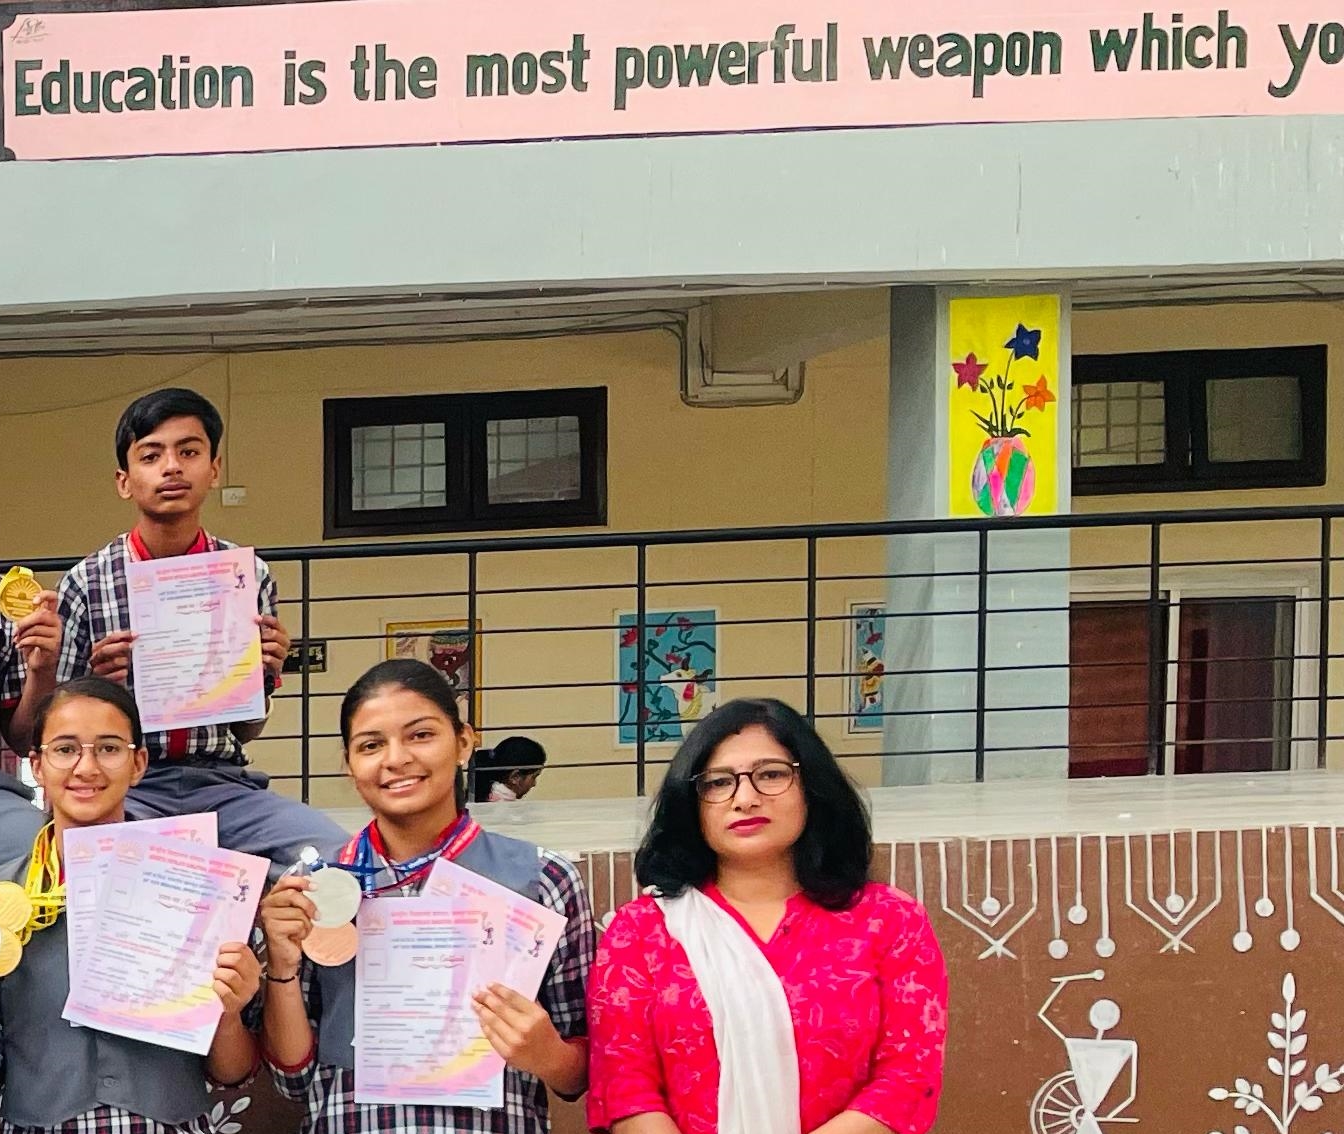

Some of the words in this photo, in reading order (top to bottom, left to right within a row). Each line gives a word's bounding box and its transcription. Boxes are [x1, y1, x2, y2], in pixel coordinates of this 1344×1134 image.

[14, 54, 254, 117] Education
[283, 50, 327, 106] is
[350, 43, 438, 102] the
[466, 33, 591, 98] most
[613, 22, 838, 111] powerful
[862, 30, 1062, 99] weapon
[1089, 9, 1248, 72] which
[1267, 22, 1344, 98] yo
